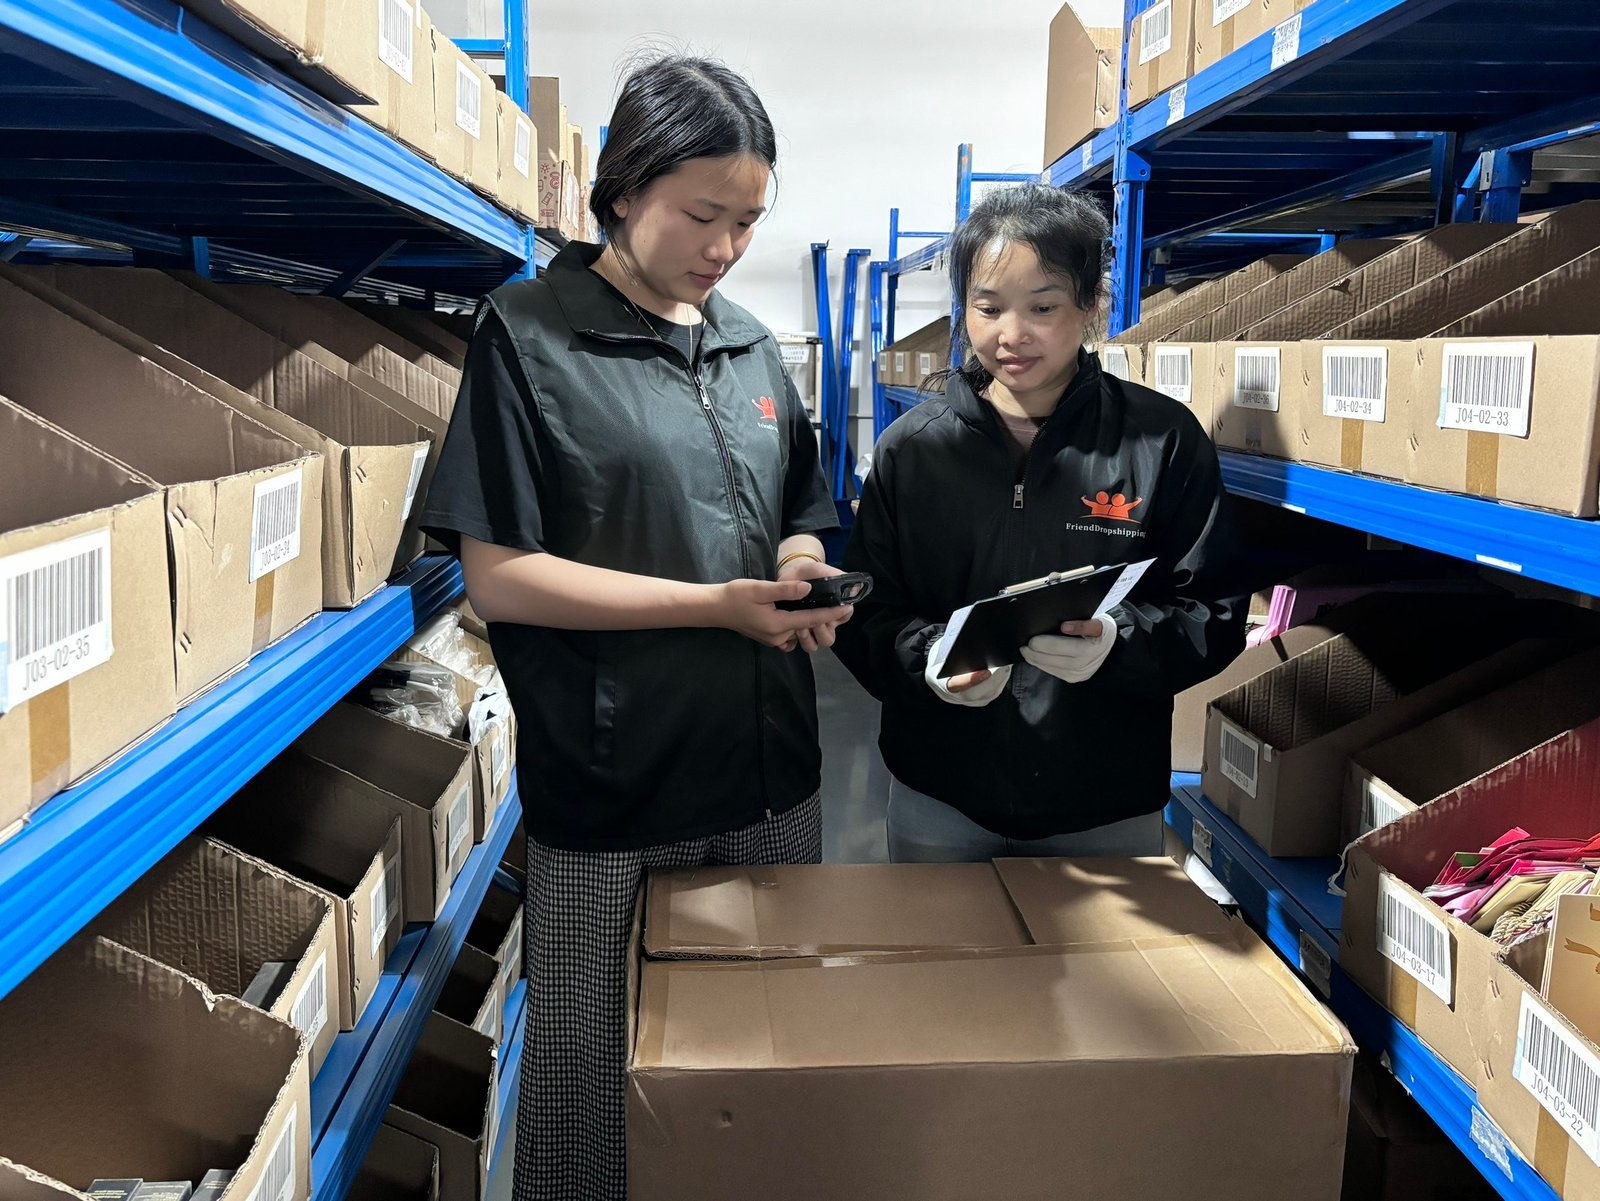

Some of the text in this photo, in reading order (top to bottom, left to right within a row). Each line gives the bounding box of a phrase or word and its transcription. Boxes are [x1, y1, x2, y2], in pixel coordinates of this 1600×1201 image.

[1241, 391, 1270, 404] J04-02-36
[1334, 399, 1372, 414] J04-02-34
[1455, 407, 1509, 427] J04-02-33
[259, 539, 290, 571] J03-02-34
[22, 634, 90, 691] J03-02-35
[1391, 942, 1436, 985] J04-03-17
[1531, 1072, 1583, 1137] J04-03-22
